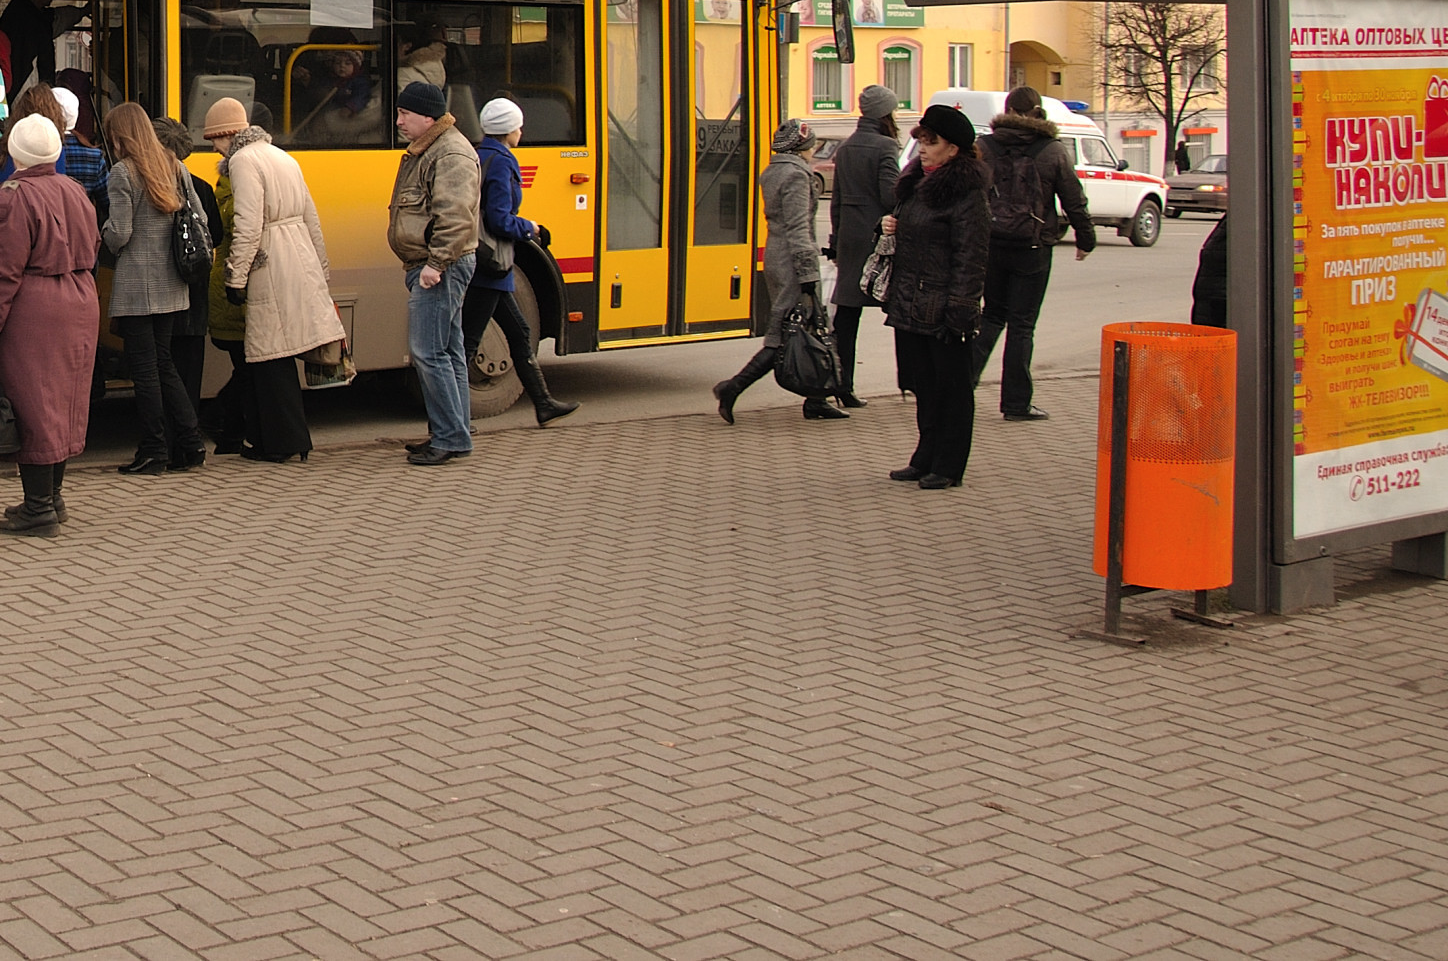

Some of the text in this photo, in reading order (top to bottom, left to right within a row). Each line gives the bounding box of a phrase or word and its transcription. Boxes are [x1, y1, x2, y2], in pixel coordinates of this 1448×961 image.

[1291, 27, 1350, 46] АПТЕКА
[1355, 27, 1427, 46] ОПТОВЫХ
[1322, 89, 1330, 102] 4
[1331, 90, 1361, 105] октября
[1363, 92, 1374, 102] по
[1375, 88, 1385, 101] 30
[1335, 163, 1448, 210] НАКОПИ
[1321, 224, 1336, 238] За
[1337, 225, 1359, 237] пять
[1361, 221, 1402, 237] покупок
[1407, 217, 1445, 230] аптеке
[1323, 247, 1446, 278] ГАРАНТИРОВАННЫЙ
[1351, 275, 1397, 306] ПРИЗ
[1323, 318, 1370, 336] Придумай
[1329, 332, 1390, 350] слоган на тему
[1360, 351, 1366, 359] и
[1345, 367, 1351, 375] и
[1352, 363, 1380, 375] получи
[1329, 378, 1375, 393] выиграть
[1349, 384, 1430, 409] ЖК-ТЕЛЕВИЗОР!!!
[1317, 463, 1352, 480] Единая
[1355, 452, 1409, 473] справочная
[1367, 468, 1420, 495] 511-222
